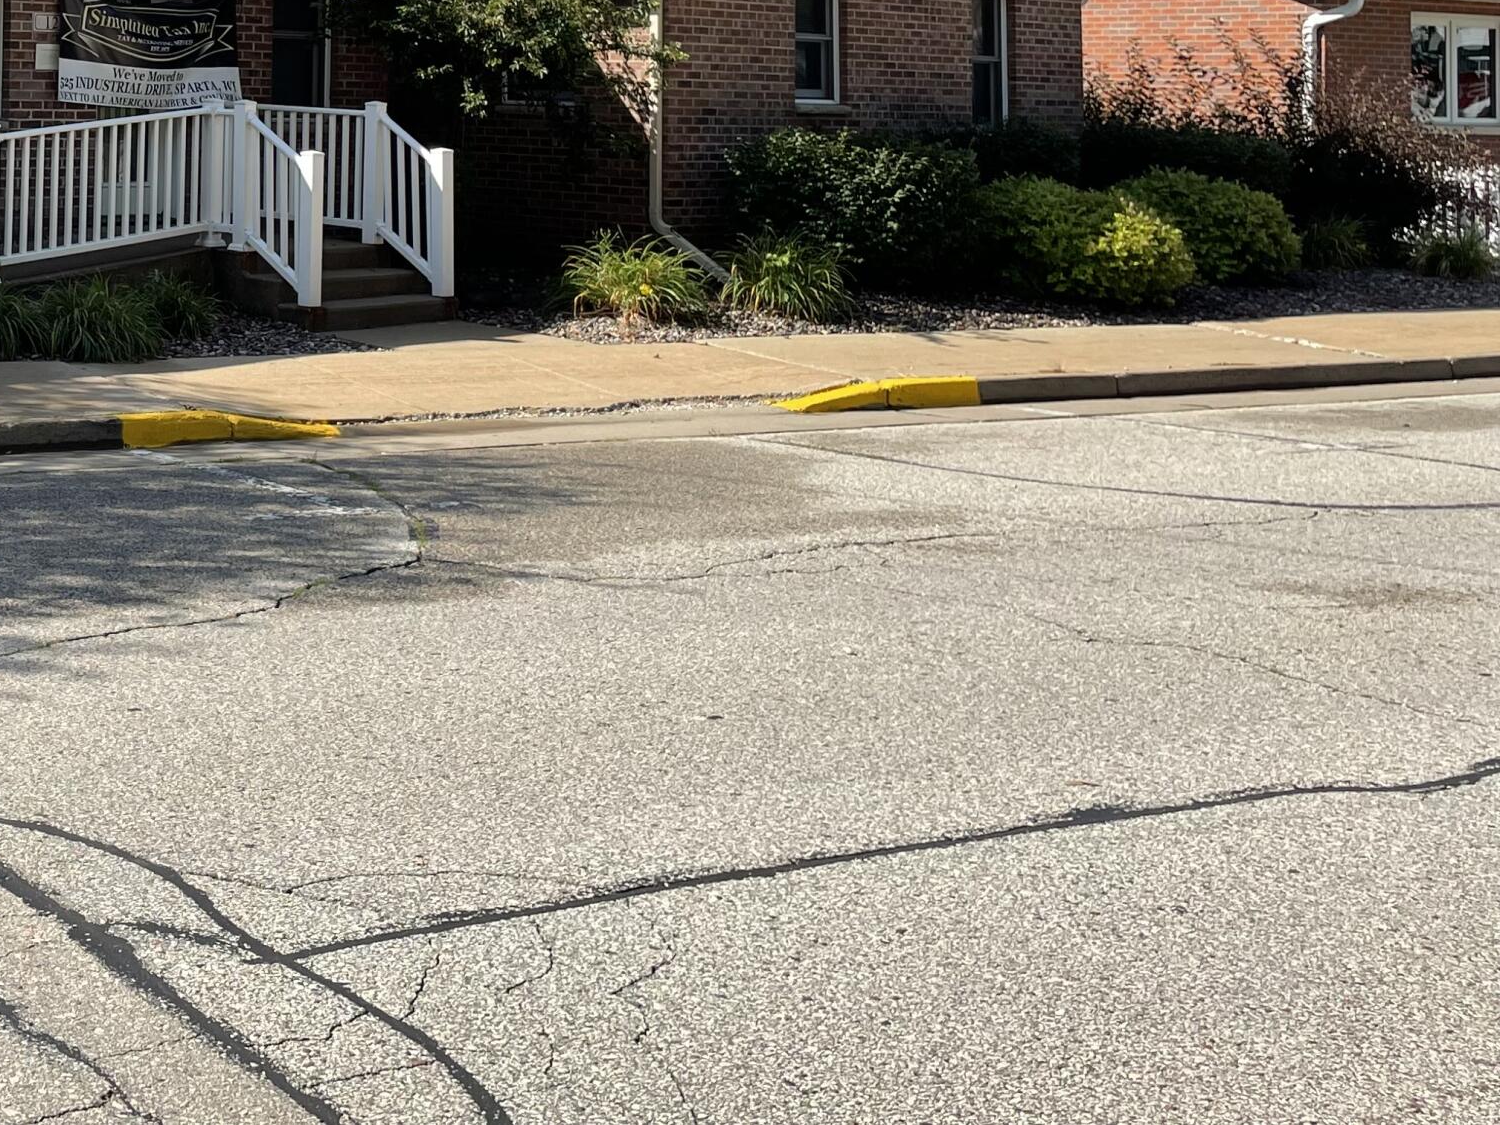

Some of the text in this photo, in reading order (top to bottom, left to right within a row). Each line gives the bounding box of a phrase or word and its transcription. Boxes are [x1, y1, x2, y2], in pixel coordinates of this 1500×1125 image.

[113, 67, 184, 82] We've Moved to
[60, 77, 74, 90] 525
[75, 76, 142, 95] INDUSTRIAL
[222, 80, 237, 92] WI
[60, 91, 78, 102] NEXT
[79, 93, 90, 103] TO
[91, 94, 106, 104] ALL
